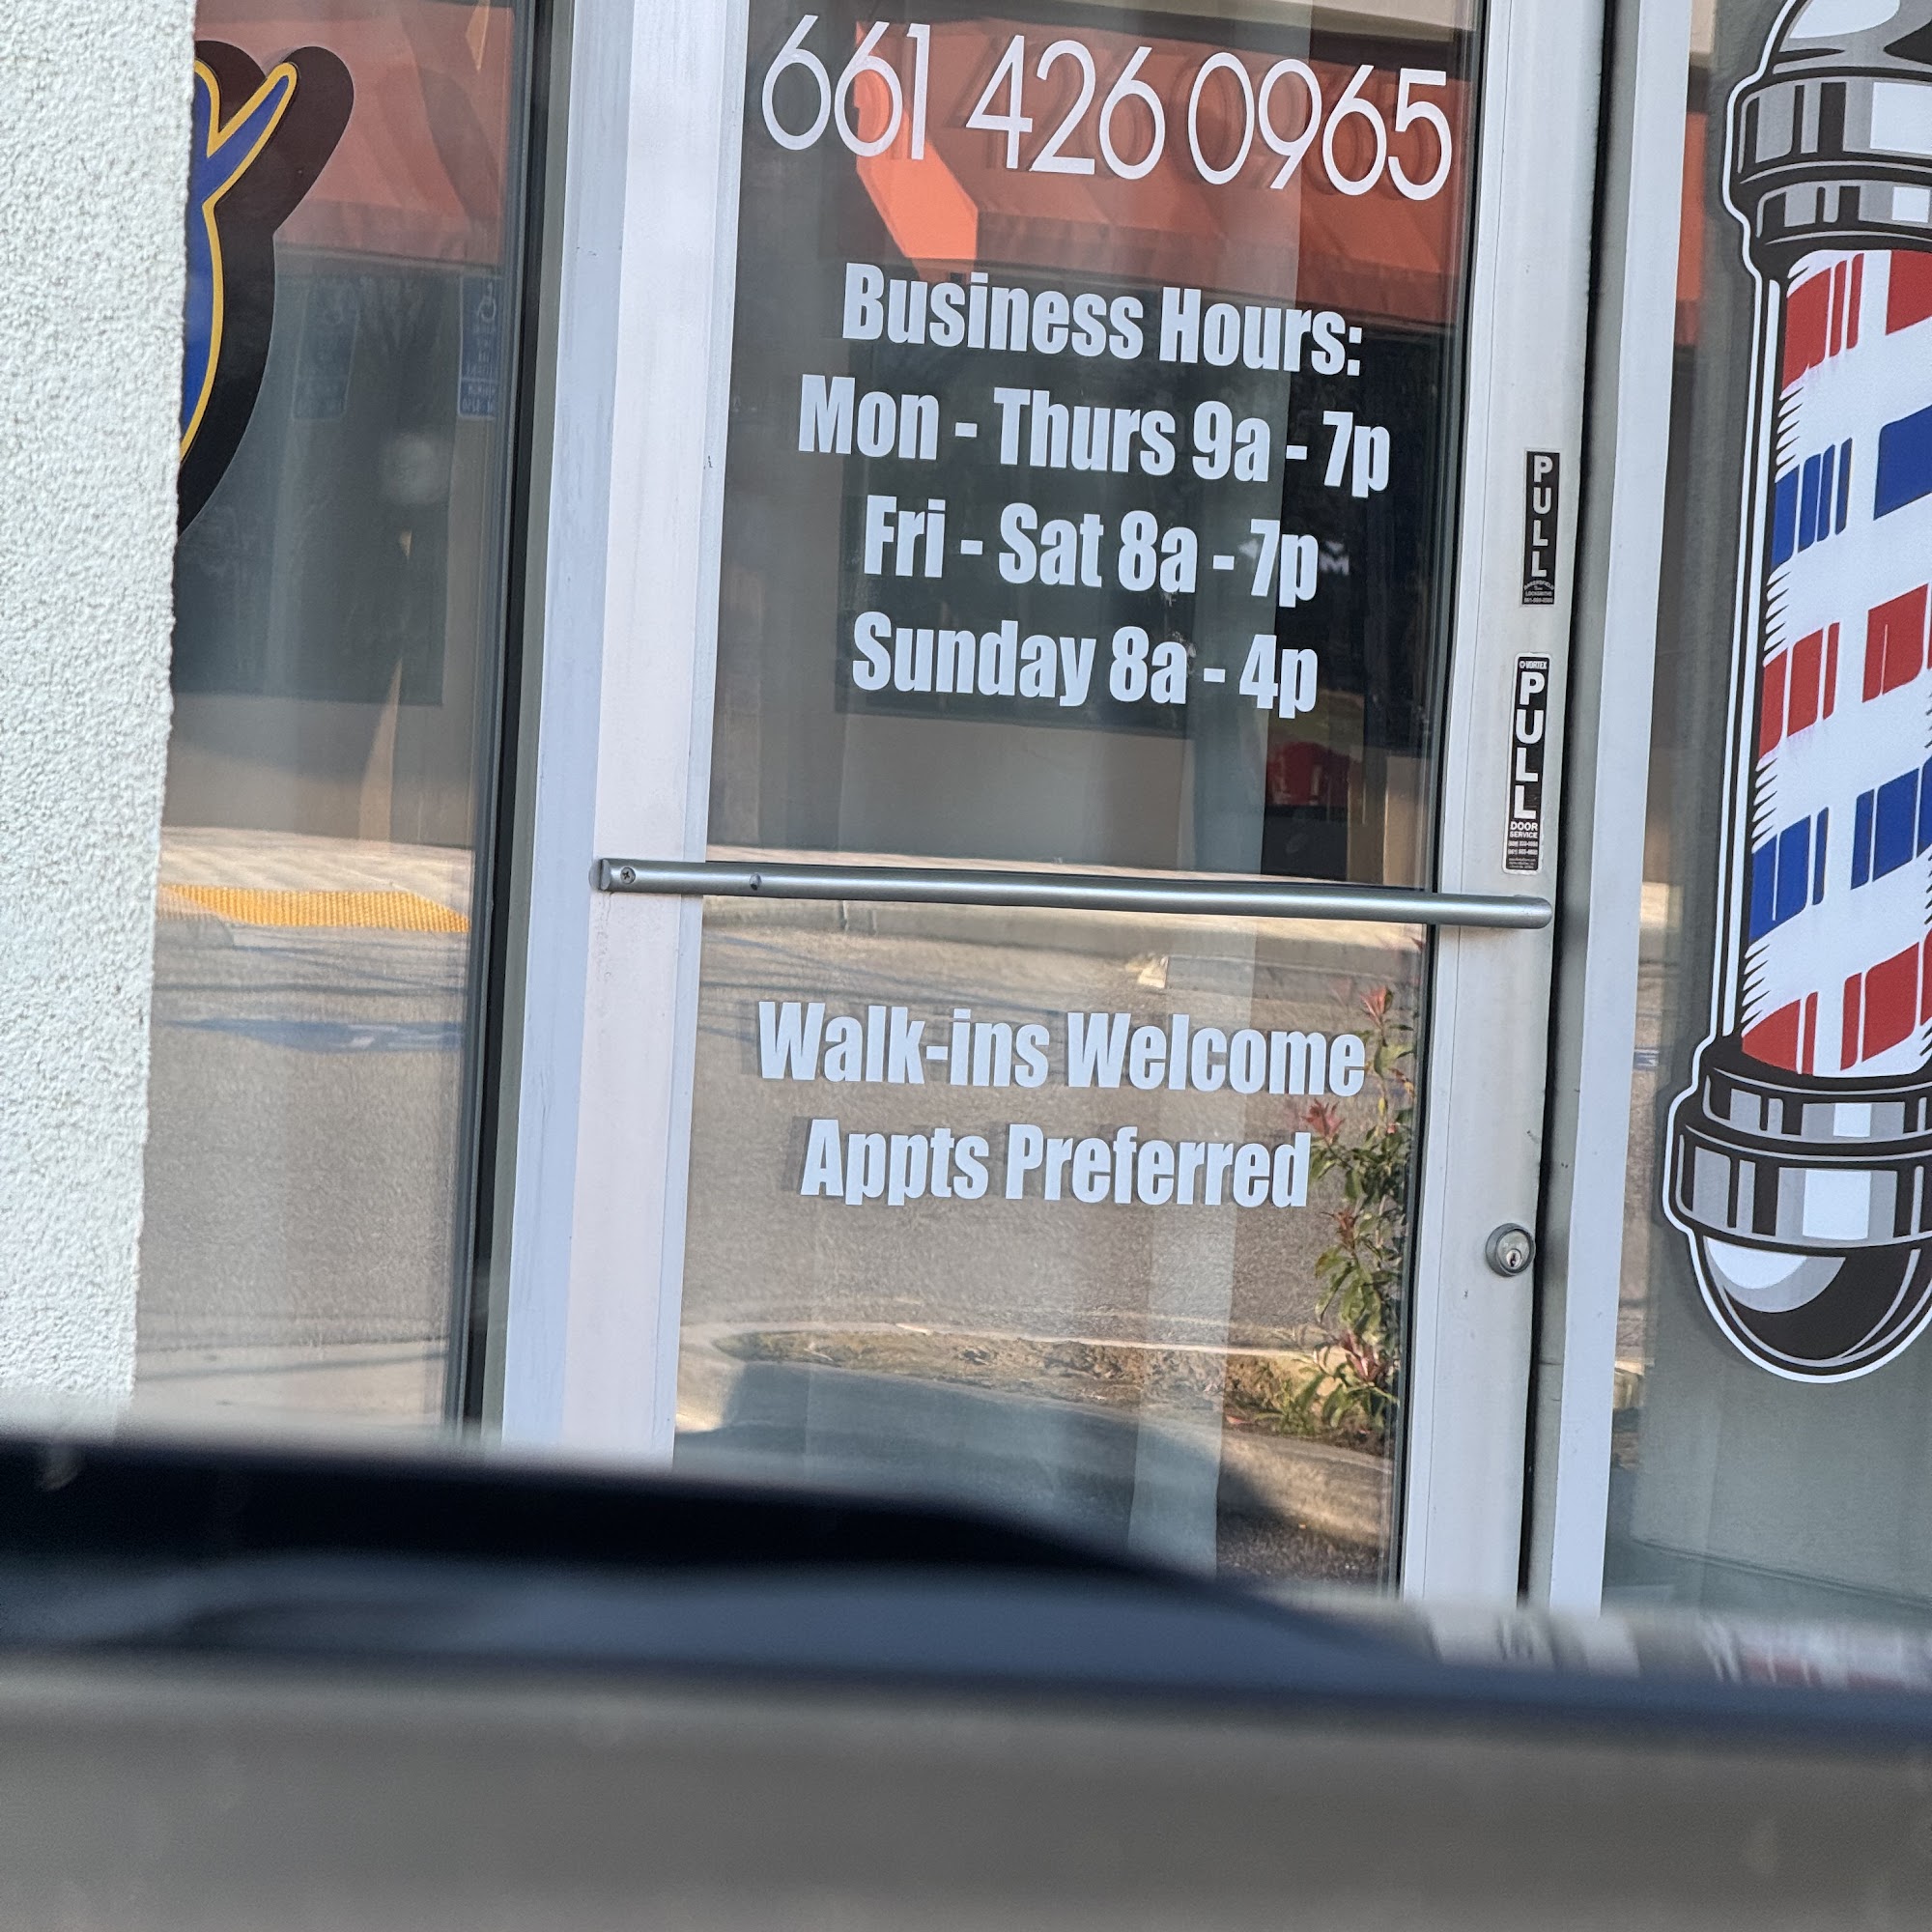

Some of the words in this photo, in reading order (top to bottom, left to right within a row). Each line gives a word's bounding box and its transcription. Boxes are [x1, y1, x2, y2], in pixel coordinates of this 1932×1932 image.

[761, 14, 931, 162] 661
[966, 34, 1166, 181] 426
[1187, 50, 1453, 201] 0965
[842, 262, 1144, 359] Business
[1159, 287, 1362, 377] Hours:
[798, 374, 939, 461] Mon
[954, 421, 977, 438] -
[994, 387, 1176, 476] Thurs
[1192, 401, 1270, 482] 9a
[1286, 444, 1307, 461] -
[1322, 411, 1390, 497] 7p
[864, 495, 946, 579] Fri
[960, 539, 982, 555] -
[998, 502, 1103, 587] Sat
[1118, 510, 1198, 593] 8a
[1212, 554, 1235, 571] -
[1250, 519, 1318, 608] 7p
[1532, 455, 1553, 577] PULL
[852, 611, 1096, 707] Sunday
[1109, 626, 1188, 705] 8a
[1204, 668, 1225, 683] -
[1239, 634, 1318, 719] 4p
[1514, 671, 1545, 819] PULL
[1510, 821, 1538, 831] DOOR
[758, 1001, 1050, 1088] Walk-ins
[1067, 1012, 1366, 1096] Welcome
[800, 1119, 989, 1206] Appts
[1006, 1123, 1311, 1208] Preferred
